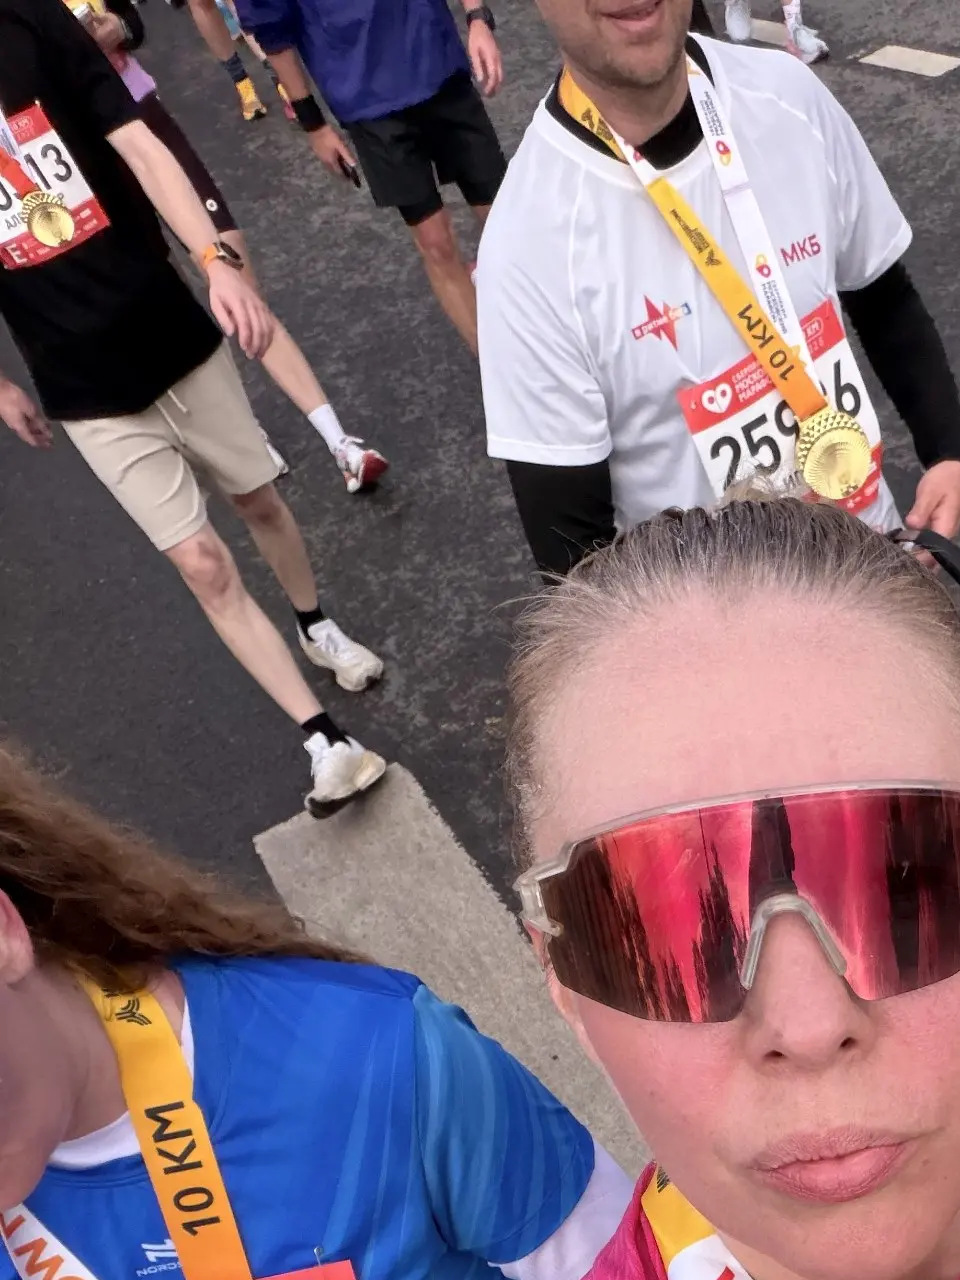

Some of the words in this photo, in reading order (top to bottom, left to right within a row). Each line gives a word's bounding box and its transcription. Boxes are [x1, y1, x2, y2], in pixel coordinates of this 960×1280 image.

[780, 233, 821, 267] МКБ
[769, 349, 795, 381] 10
[711, 359, 861, 491] 2596
[144, 1099, 204, 1176] КМ
[173, 1186, 221, 1238] 10
